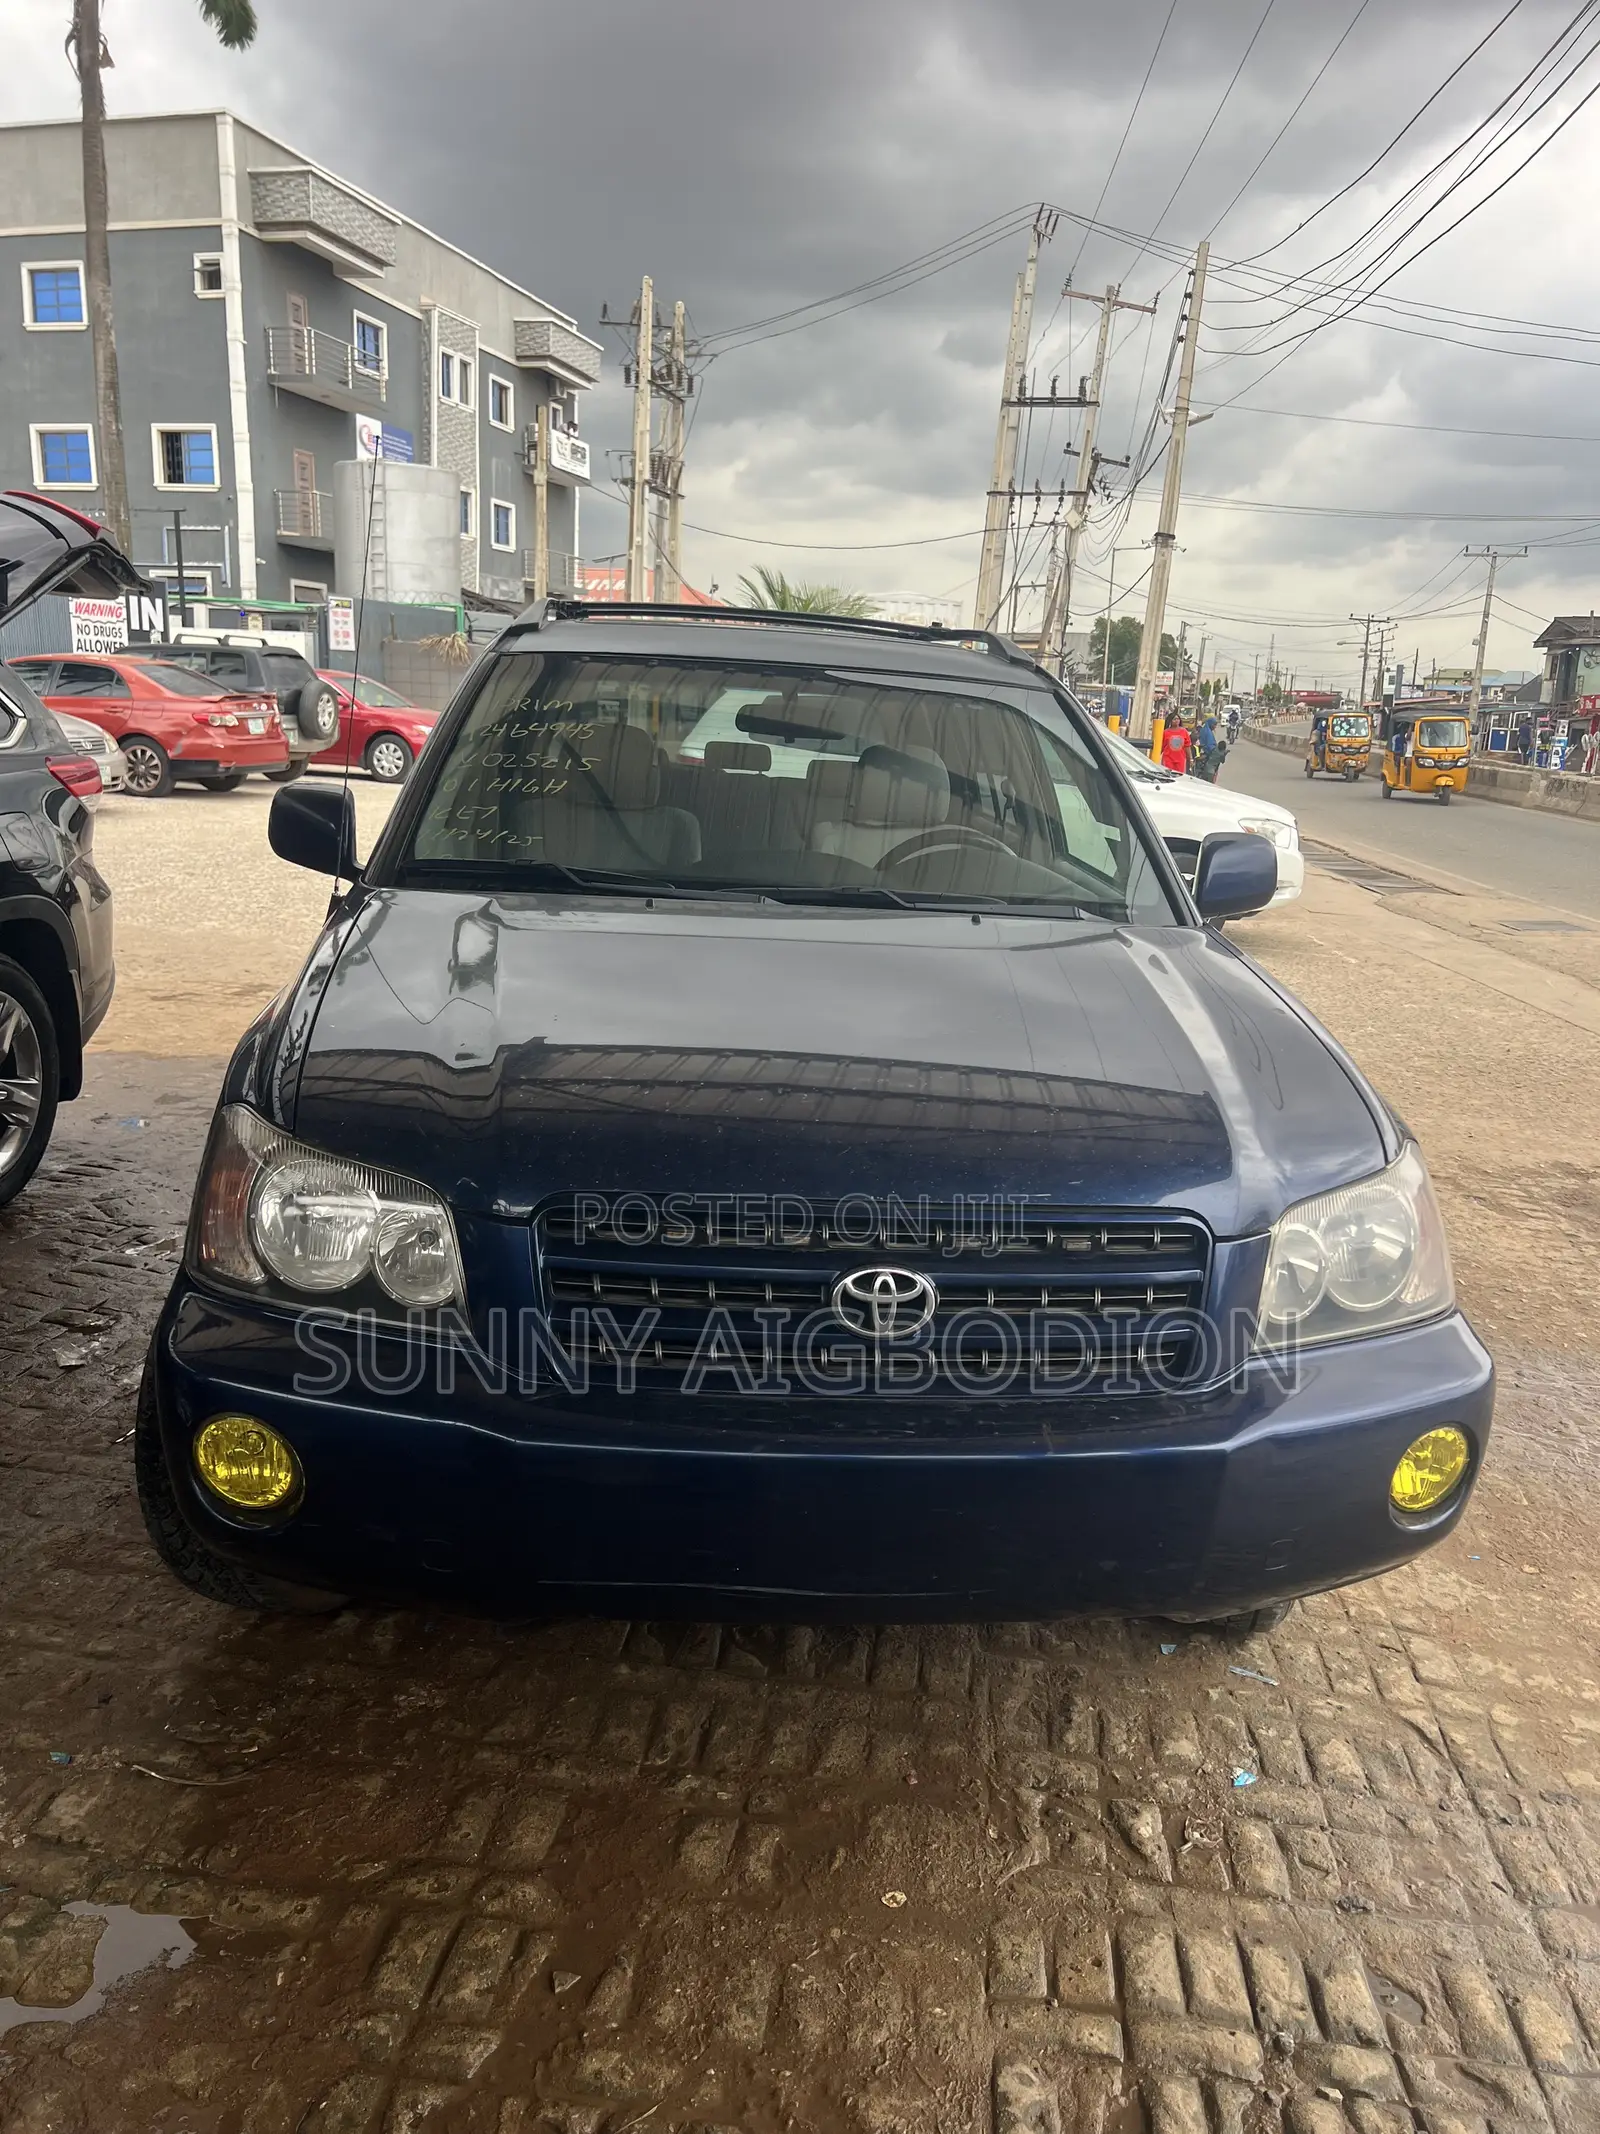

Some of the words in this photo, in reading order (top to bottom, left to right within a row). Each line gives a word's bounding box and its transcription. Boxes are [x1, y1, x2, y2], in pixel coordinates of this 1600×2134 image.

[75, 602, 123, 619] WARNING
[129, 595, 164, 632] IN
[76, 623, 91, 636] NO
[93, 624, 123, 638] DRUGS
